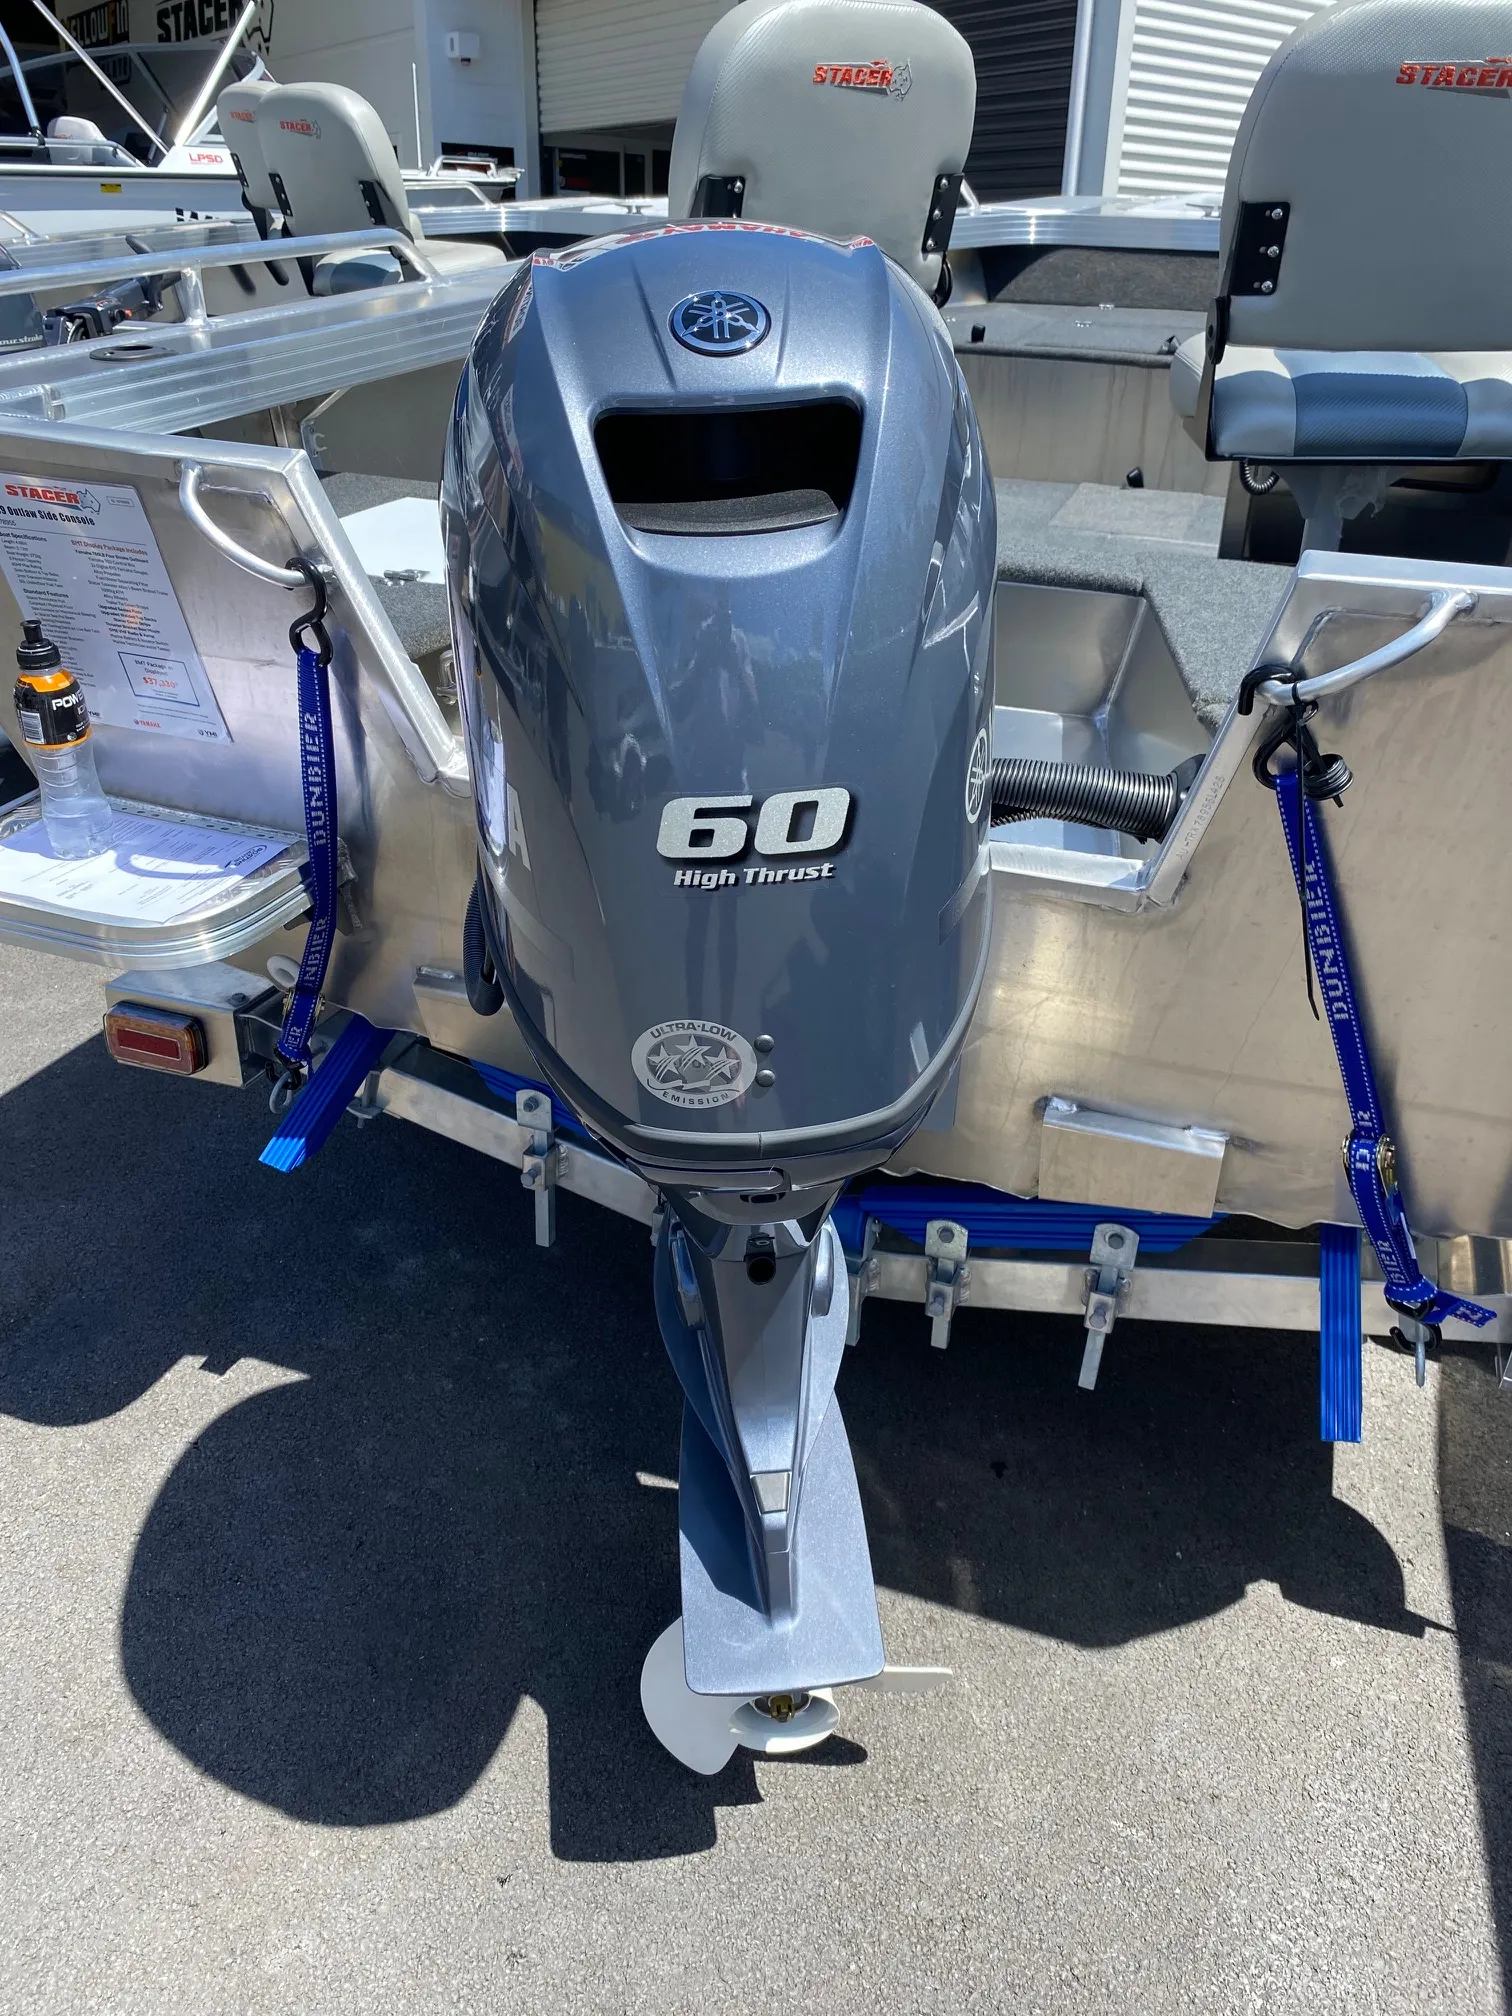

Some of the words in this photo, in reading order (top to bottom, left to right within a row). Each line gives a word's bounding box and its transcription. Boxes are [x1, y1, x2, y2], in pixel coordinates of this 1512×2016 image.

[811, 65, 893, 87] STACER
[280, 120, 312, 132] STACER
[5, 484, 80, 504] STACER
[7, 506, 38, 519] Outlaw
[38, 511, 58, 522] Side
[59, 513, 95, 526] Console
[304, 713, 327, 846] DUNBIER
[656, 787, 850, 858] 60
[674, 869, 736, 889] High
[743, 862, 834, 885] Thrust
[662, 1090, 730, 1105] EMISSION
